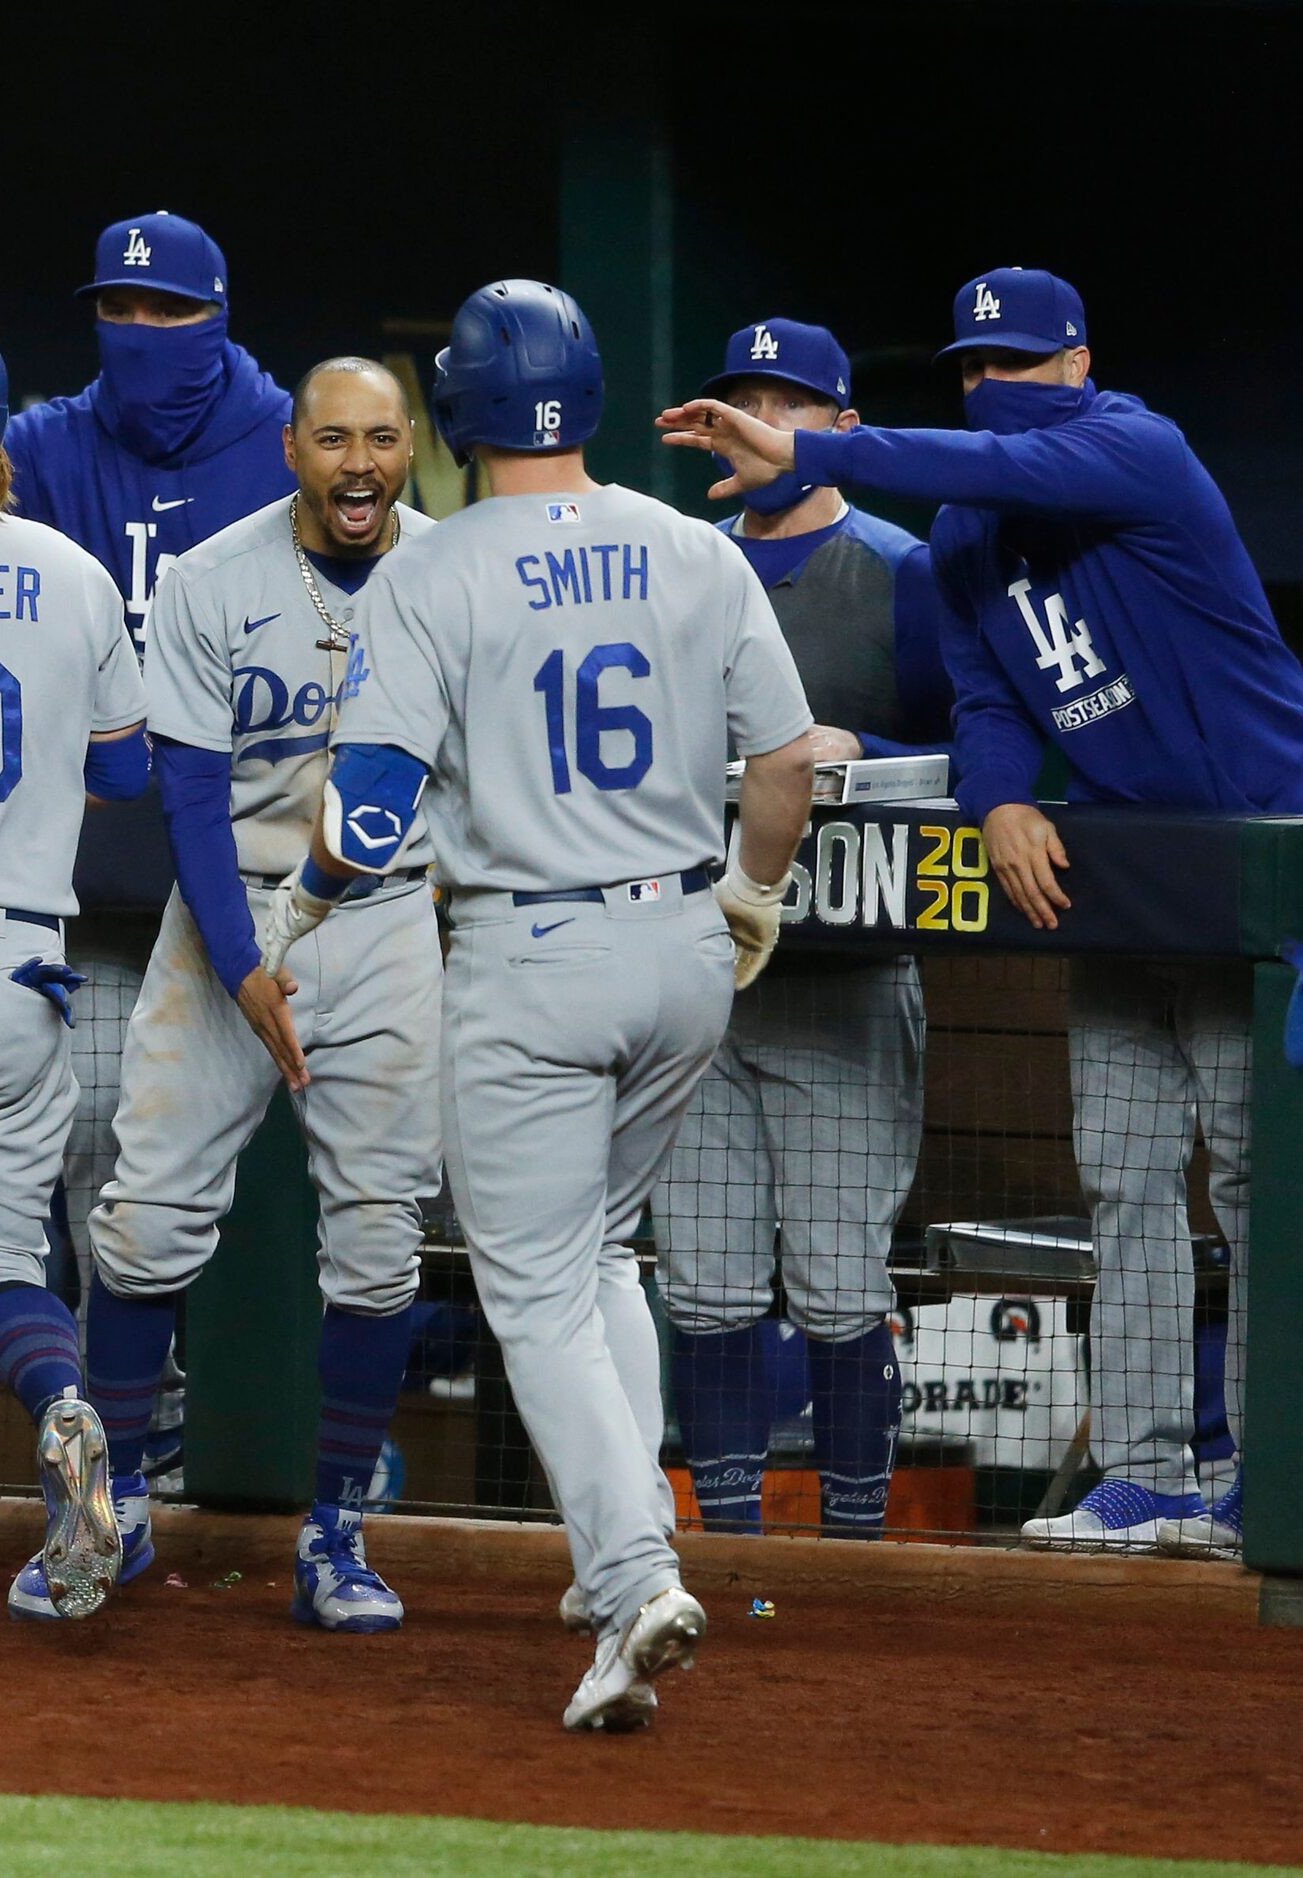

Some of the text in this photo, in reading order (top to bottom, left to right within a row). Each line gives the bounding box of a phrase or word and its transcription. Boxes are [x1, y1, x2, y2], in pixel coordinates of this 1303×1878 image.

[123, 228, 152, 266] LA
[973, 282, 1001, 321] LA
[750, 325, 779, 360] LA
[535, 400, 562, 431] 16
[515, 545, 648, 611] SMITH
[1008, 578, 1107, 693] LA
[534, 642, 653, 795] 16
[917, 825, 988, 878] 20
[916, 879, 989, 932] 20
